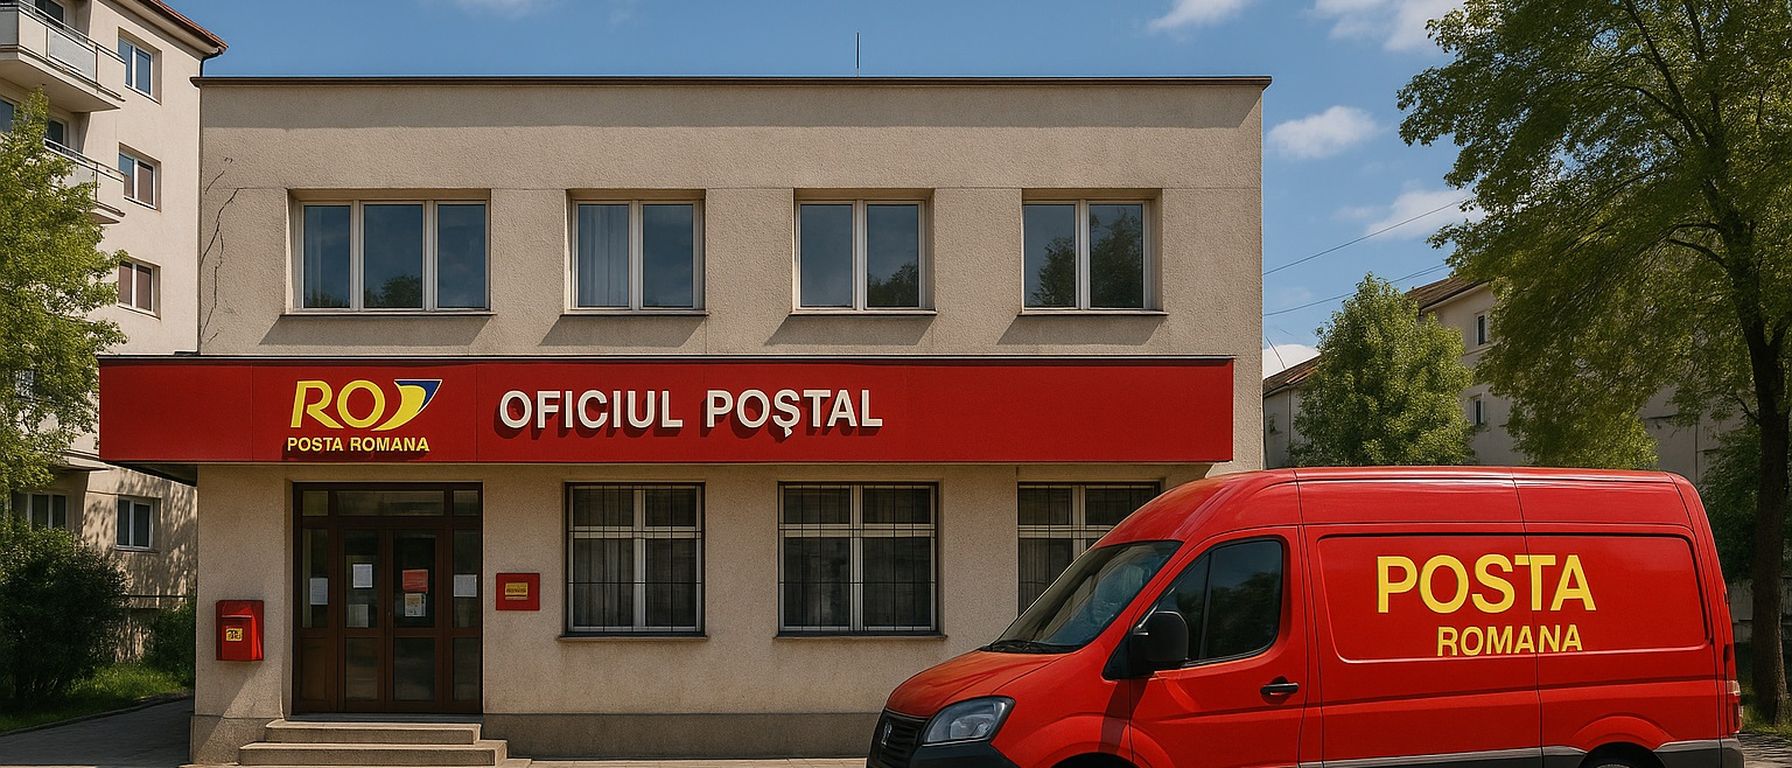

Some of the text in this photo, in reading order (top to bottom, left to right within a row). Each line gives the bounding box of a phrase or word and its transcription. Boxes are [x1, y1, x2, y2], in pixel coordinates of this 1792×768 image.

[499, 390, 683, 429] OFICIUL
[287, 437, 430, 452] POSTA ROMANA
[1376, 553, 1597, 614] POSTA
[1437, 624, 1583, 657] ROMANA
